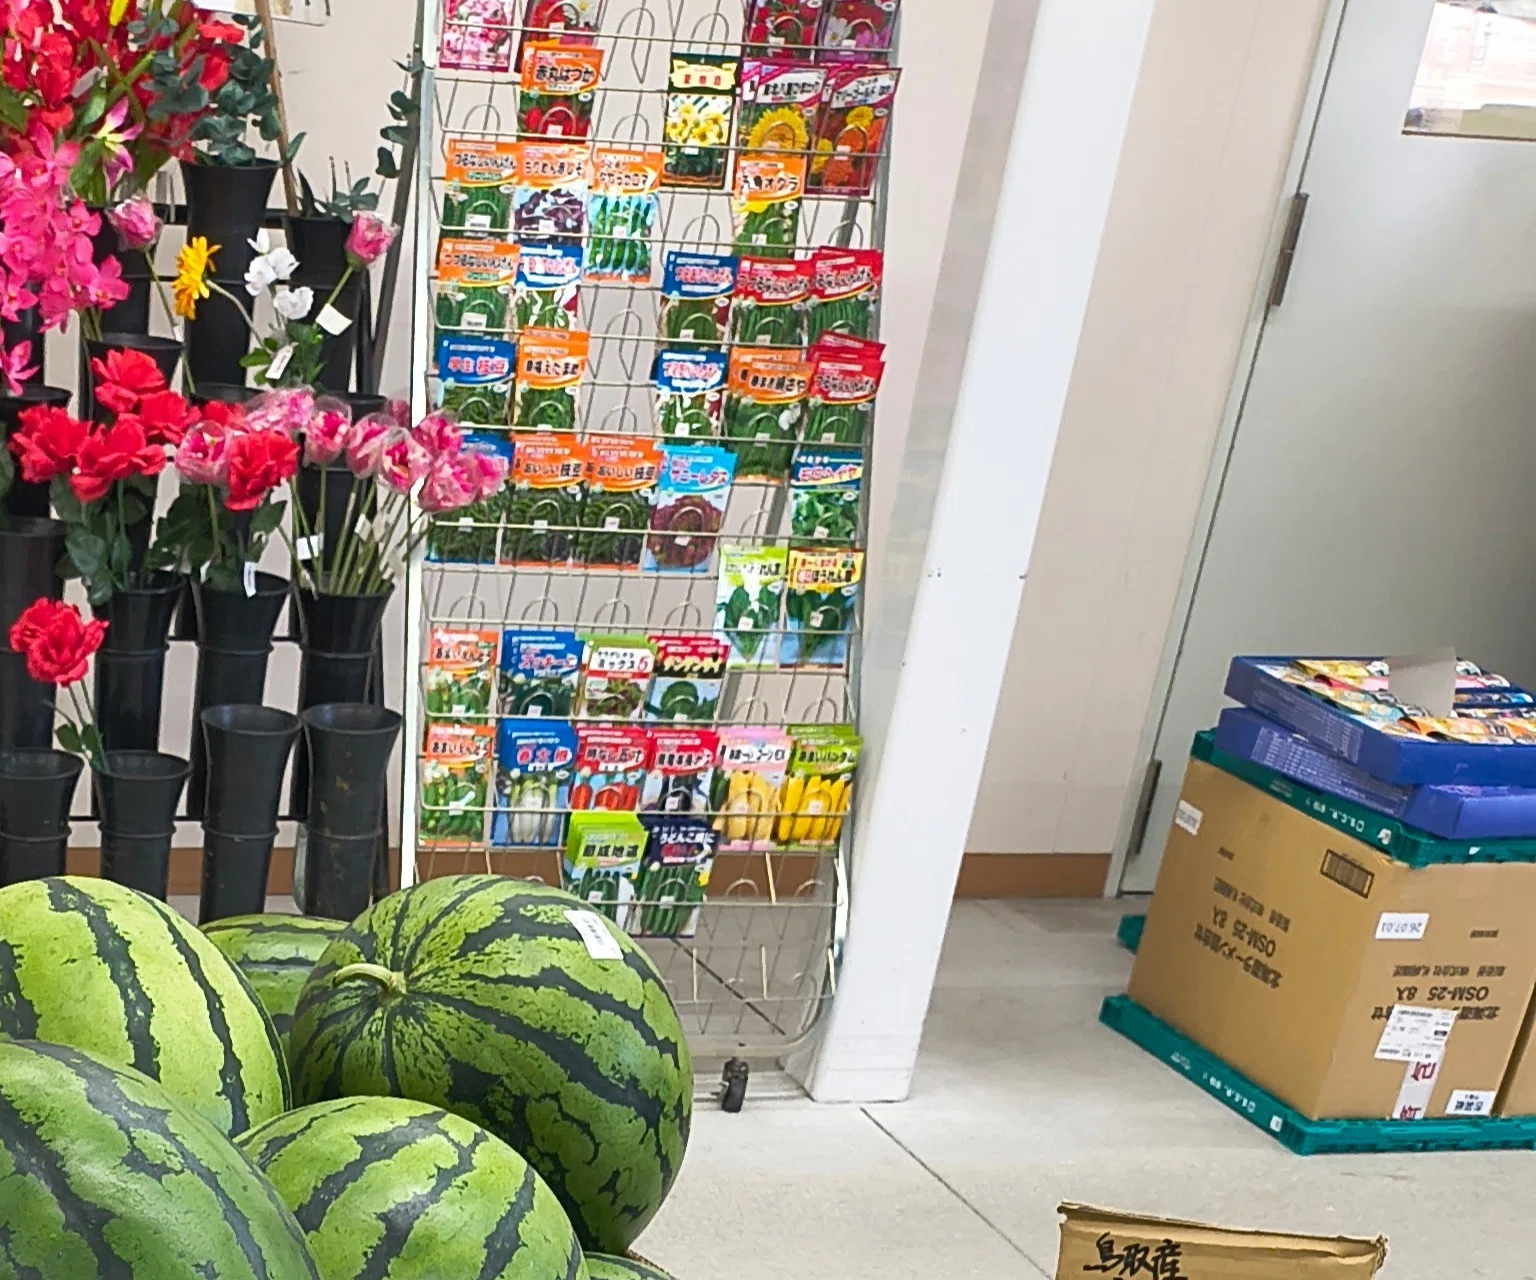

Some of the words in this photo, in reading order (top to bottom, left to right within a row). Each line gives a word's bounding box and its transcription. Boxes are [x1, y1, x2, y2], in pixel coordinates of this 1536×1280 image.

[1427, 986, 1489, 1001] OSM-25
[1083, 1233, 1188, 1280] 鳥取産
